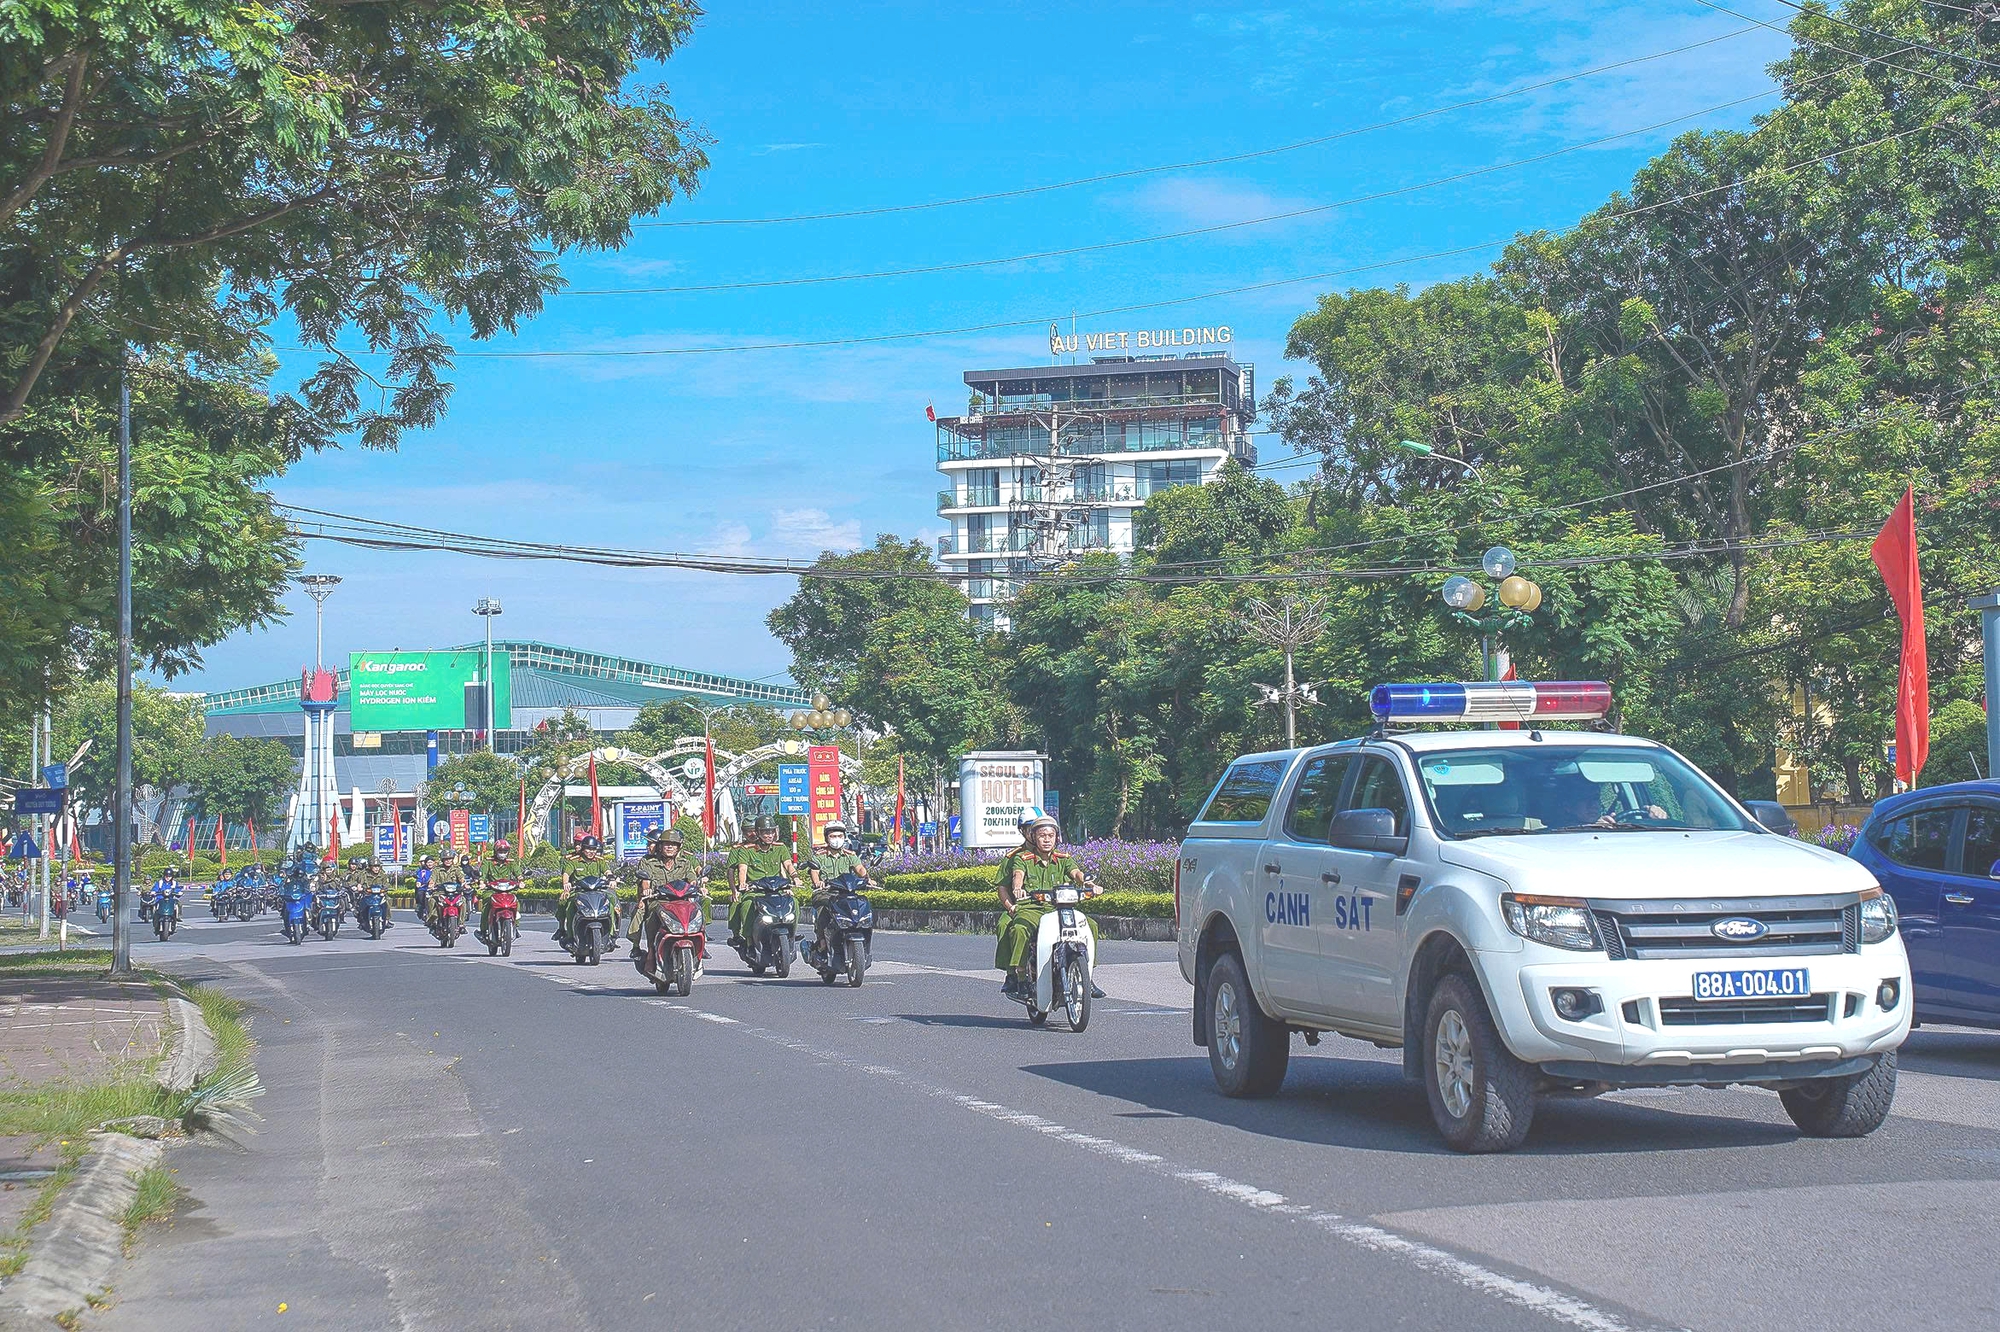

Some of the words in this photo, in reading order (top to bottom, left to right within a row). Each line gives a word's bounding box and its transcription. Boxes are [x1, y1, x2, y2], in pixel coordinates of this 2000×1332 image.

[1052, 334, 1078, 353] AU
[1086, 332, 1129, 352] VIET
[1138, 326, 1231, 349] BUILDING
[360, 660, 427, 675] Kangaroo
[359, 697, 401, 705] HYDROGEN
[687, 767, 701, 775] VP
[980, 765, 1018, 779] SEOUL
[981, 779, 1032, 804] HOTEL
[1265, 878, 1310, 927] CẢNH
[1335, 885, 1374, 932] SÁT
[1631, 899, 1835, 914] RANGER
[1714, 920, 1757, 936] Ford
[1698, 970, 1805, 997] 88A-004.01
